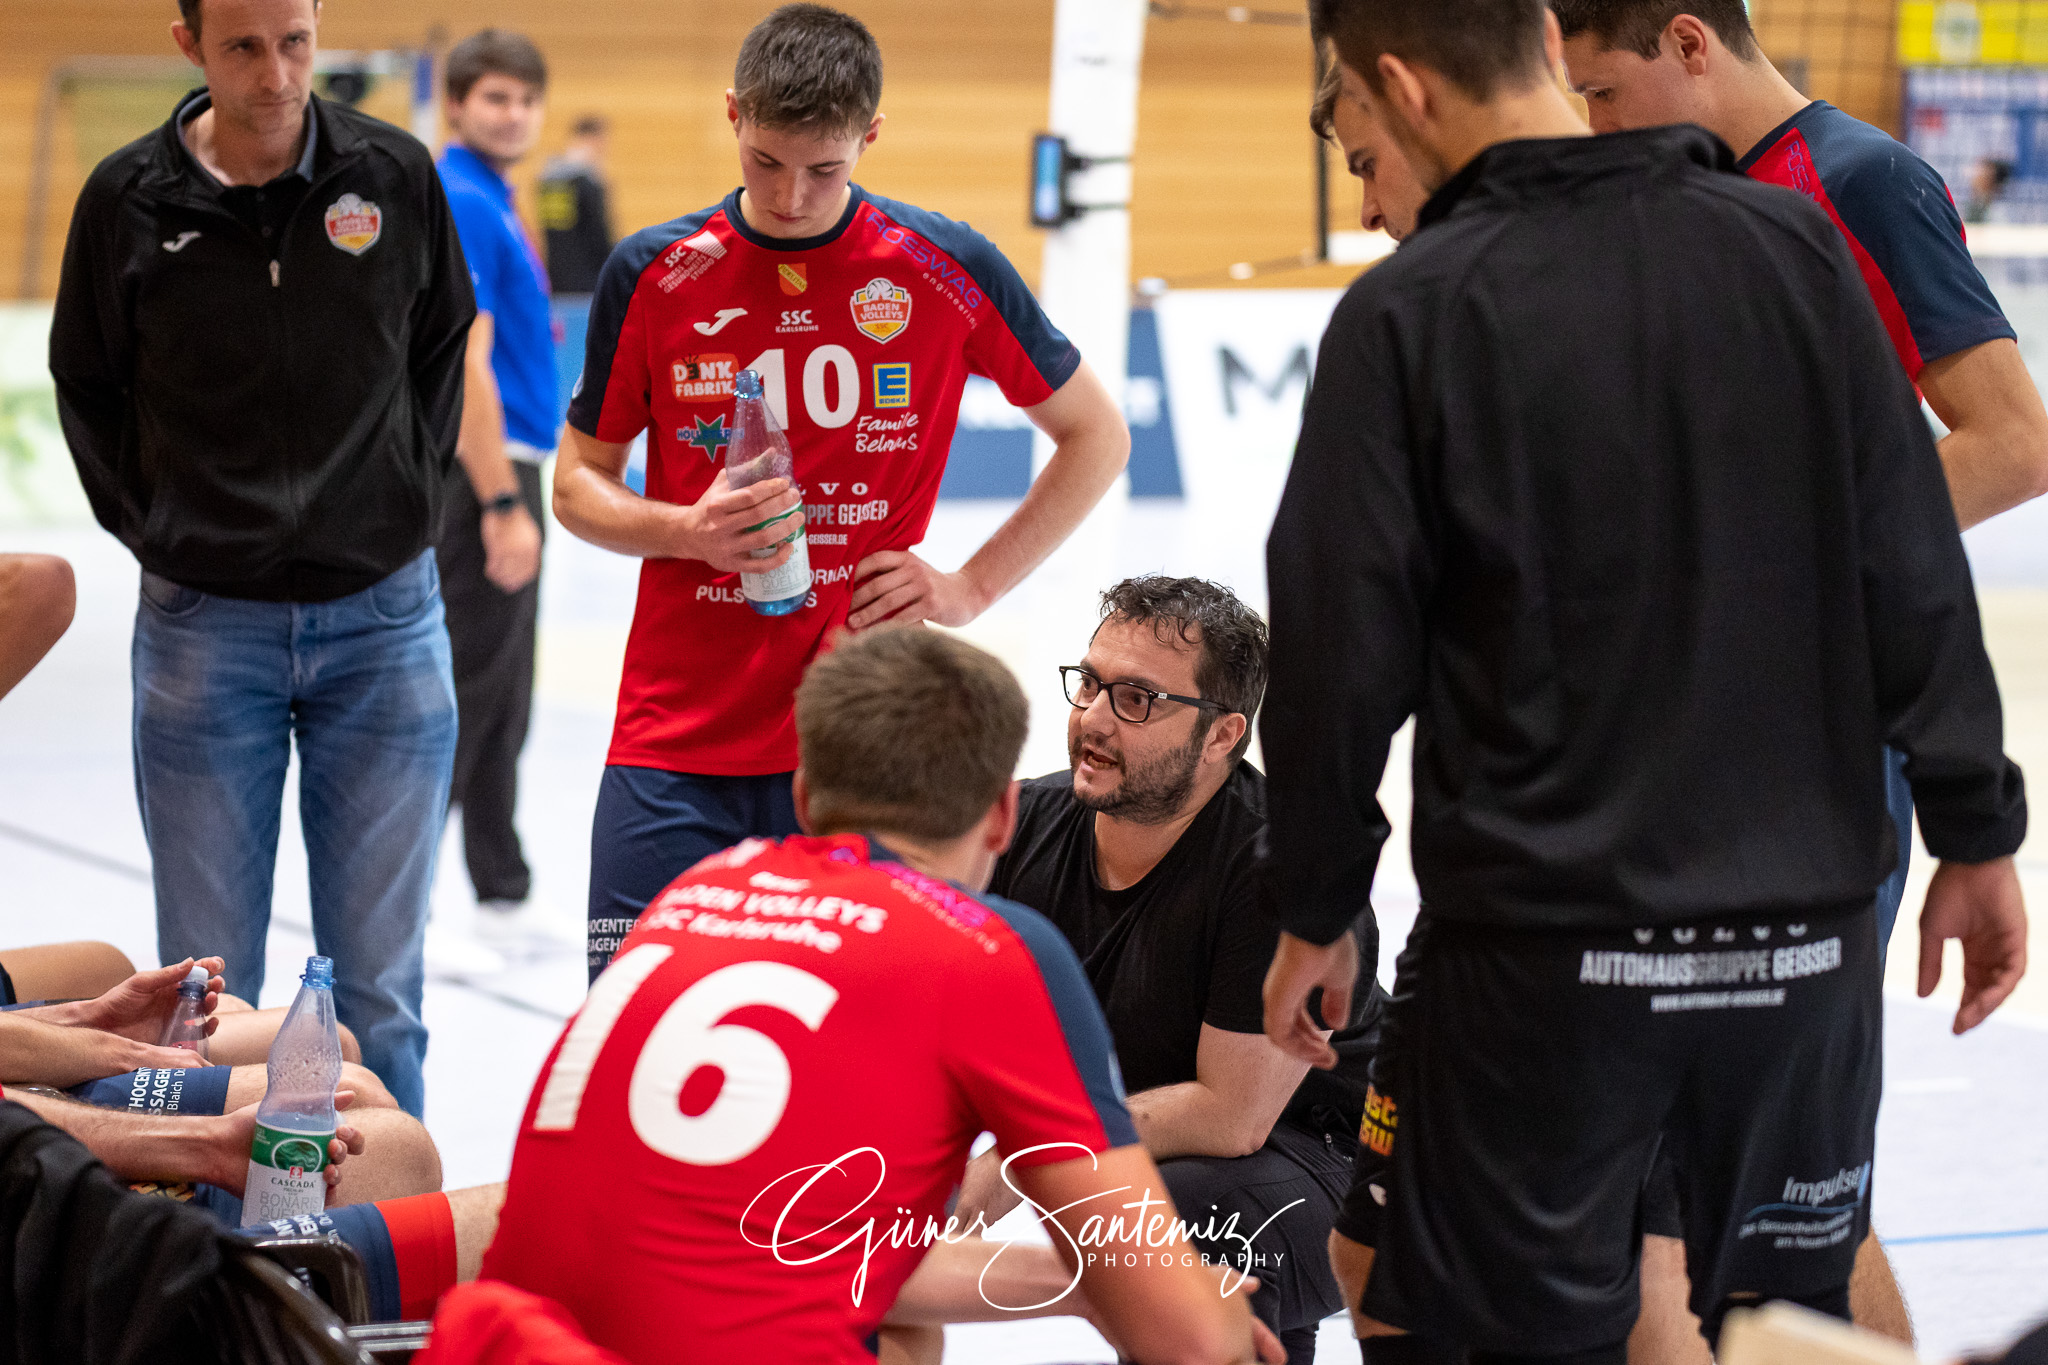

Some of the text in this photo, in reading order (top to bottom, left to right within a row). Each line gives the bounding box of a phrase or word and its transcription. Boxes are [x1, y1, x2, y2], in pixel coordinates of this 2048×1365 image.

[664, 245, 687, 268] SSC
[690, 257, 715, 281] STUDIO
[866, 211, 982, 309] ROSSWAG
[657, 264, 685, 288] FITNESS
[862, 302, 900, 312] BADEN
[922, 272, 978, 330] engineering
[775, 324, 819, 333] KARLSRUHE
[780, 309, 813, 326] SSC
[860, 311, 904, 321] VOLLEYS
[675, 380, 735, 397] FABRIK
[742, 344, 861, 430] 10
[743, 893, 889, 934] VOLLEYS
[687, 912, 842, 954] Karlsruhe
[1578, 936, 1843, 987] AUTOHAUSGRUPPE GEISSER
[533, 943, 840, 1166] 16
[166, 1081, 184, 1111] Blaich
[271, 1177, 315, 1188] CASCADA
[1782, 1166, 1863, 1208] Impulse
